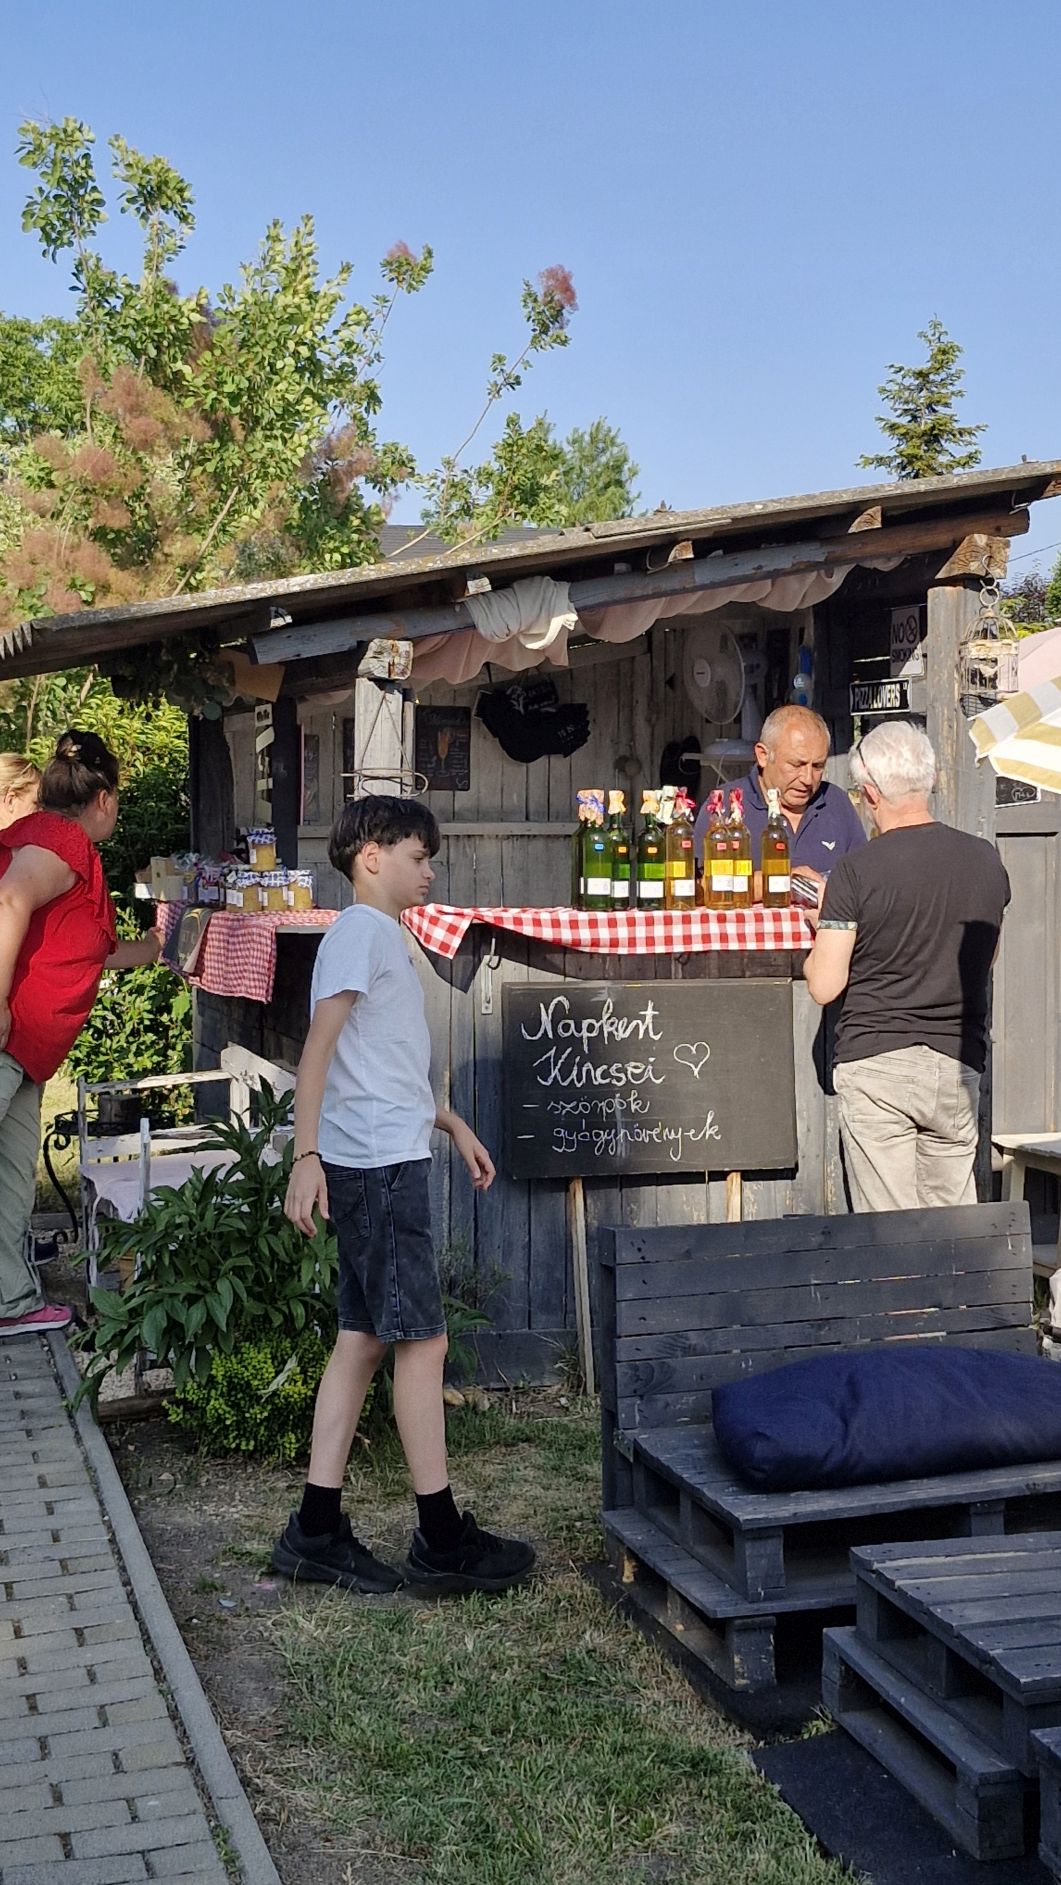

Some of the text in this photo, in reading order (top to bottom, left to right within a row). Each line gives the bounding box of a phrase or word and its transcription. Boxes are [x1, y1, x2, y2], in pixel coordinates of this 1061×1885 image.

[892, 622, 905, 644] NO
[854, 682, 901, 710] PIZZA LOVERS
